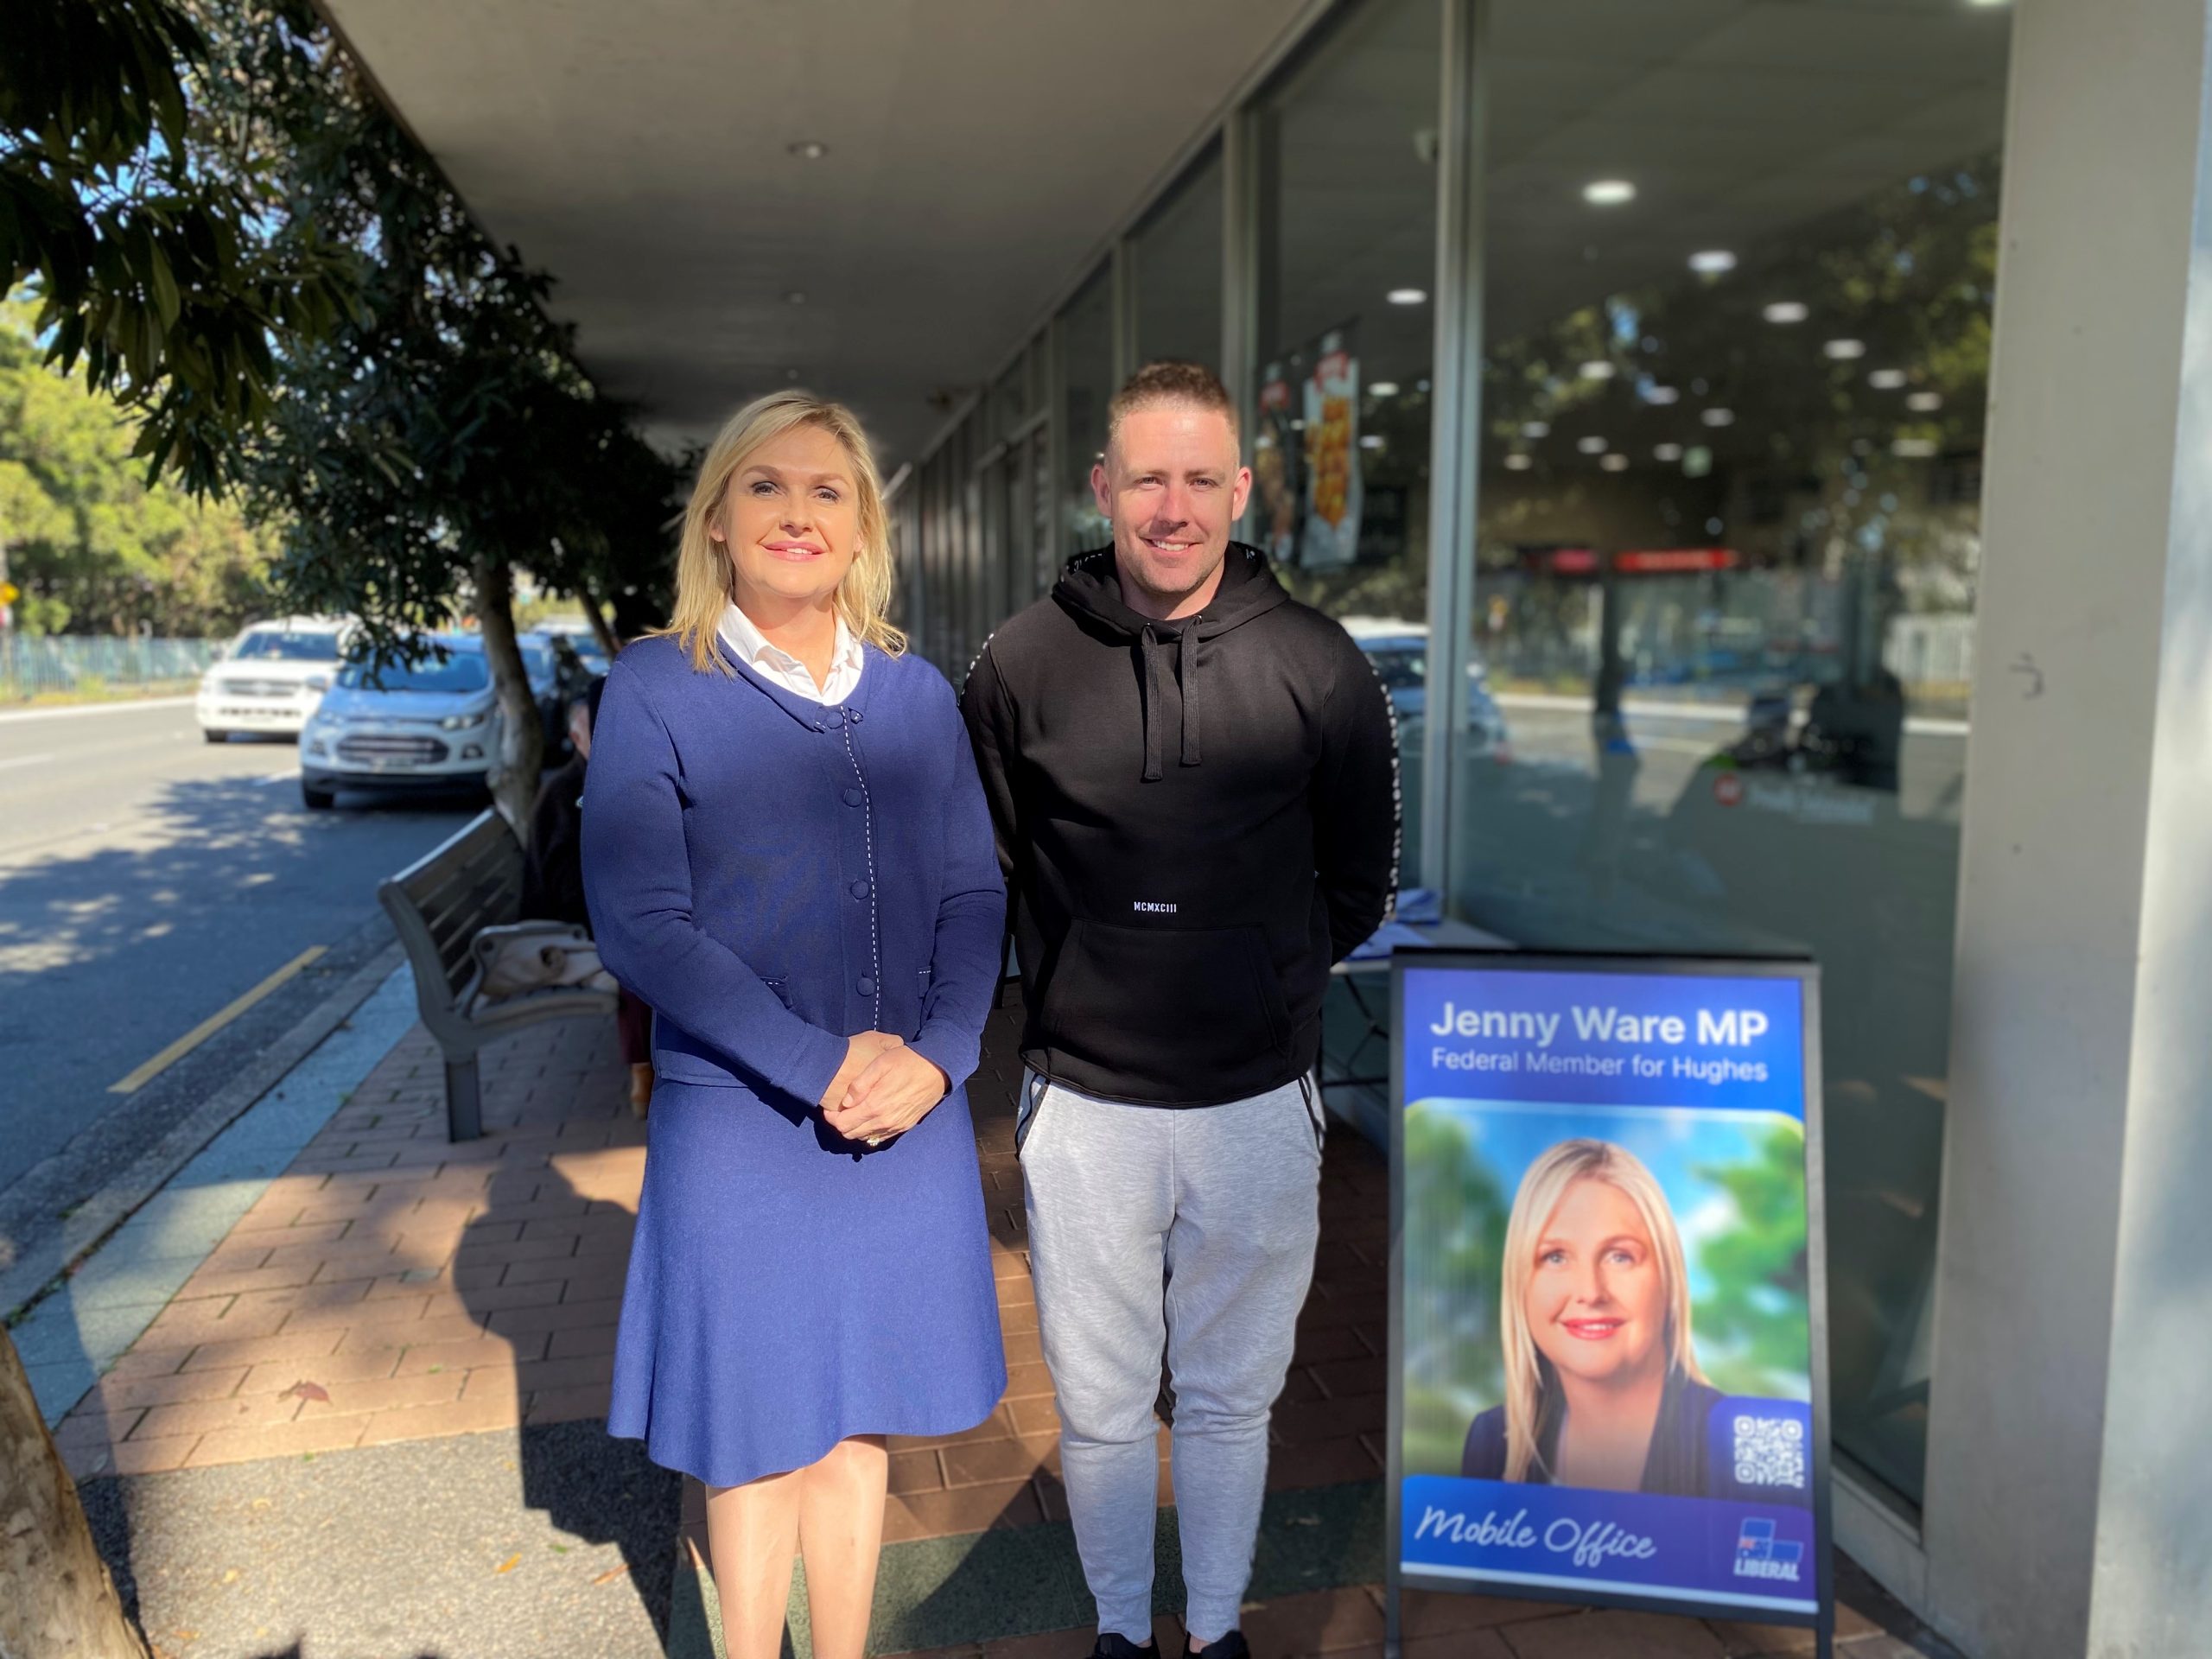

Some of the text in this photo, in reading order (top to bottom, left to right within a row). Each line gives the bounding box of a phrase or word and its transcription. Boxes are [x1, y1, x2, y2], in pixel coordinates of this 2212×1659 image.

[1134, 901, 1177, 913] MCMXCIII
[1430, 1001, 1769, 1048] Jenny Ware MP
[1432, 1047, 1769, 1085] Federal Member for Hughes
[1414, 1505, 1657, 1567] Mobile Office
[1733, 1558, 1800, 1582] LIBERAL
